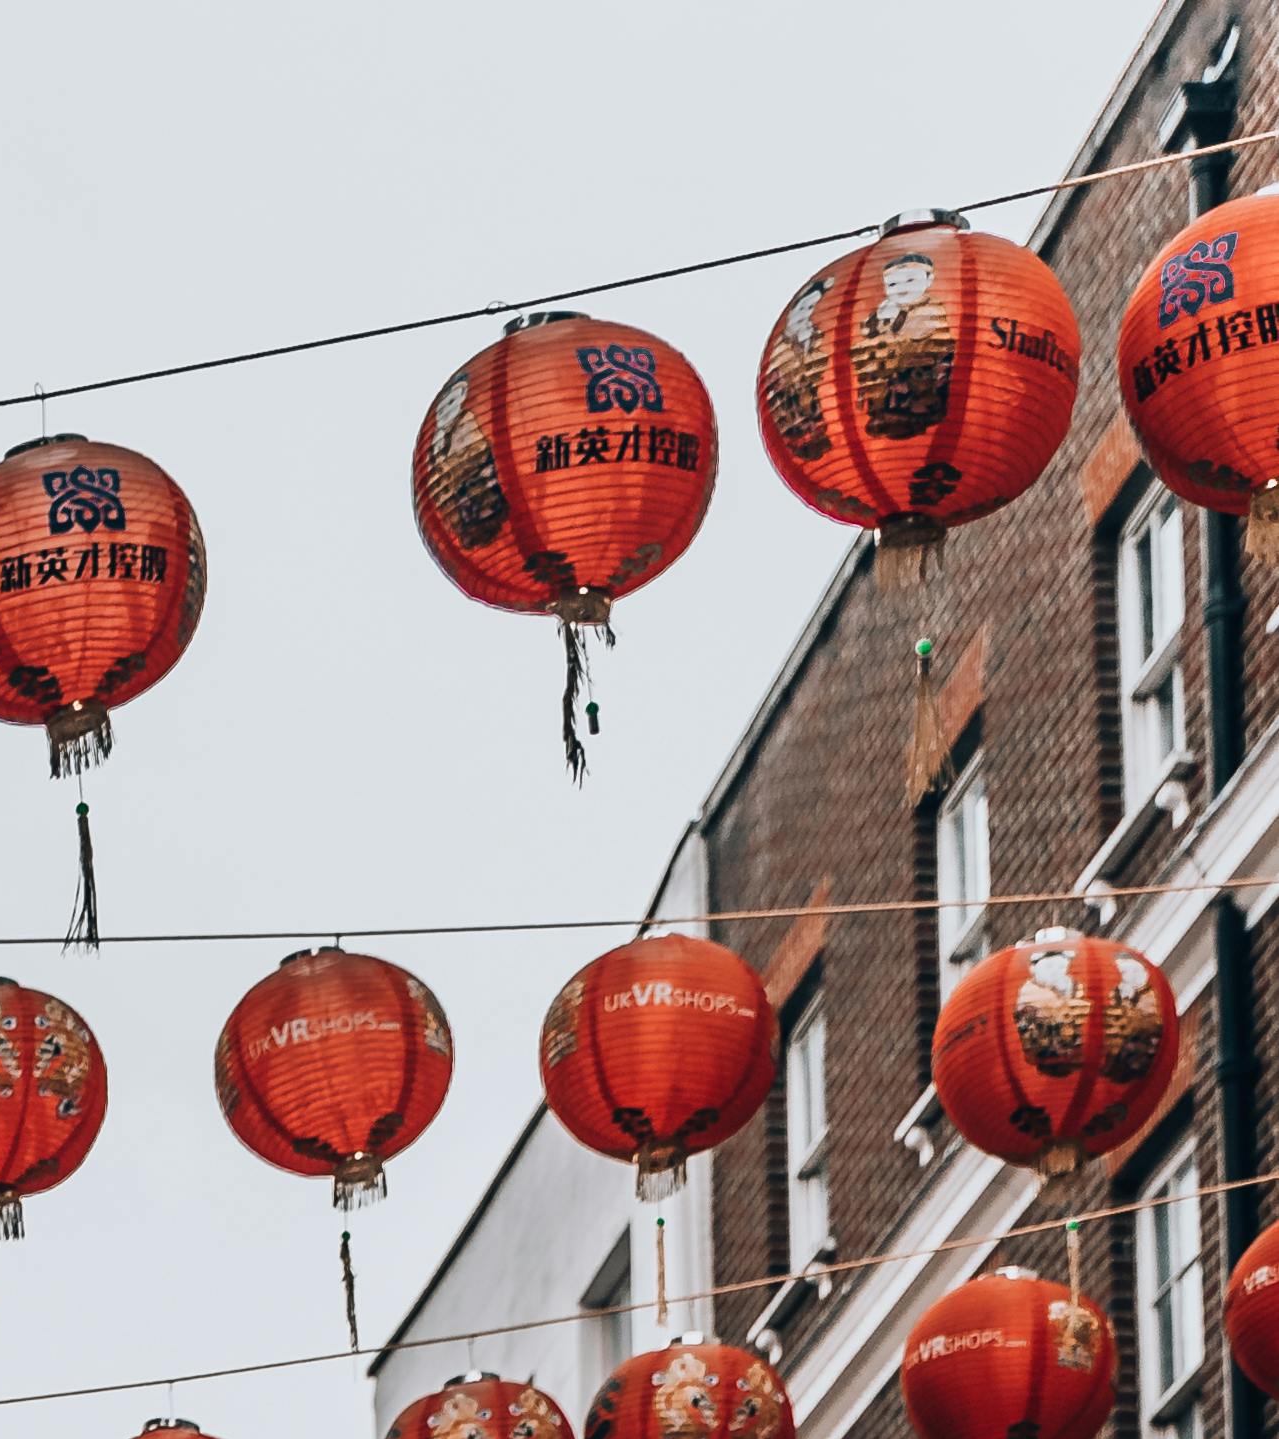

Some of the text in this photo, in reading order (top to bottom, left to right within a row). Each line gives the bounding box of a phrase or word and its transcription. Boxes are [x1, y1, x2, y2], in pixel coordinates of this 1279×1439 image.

[534, 423, 701, 473] 新英才控股
[0, 542, 168, 594] 新英才控股
